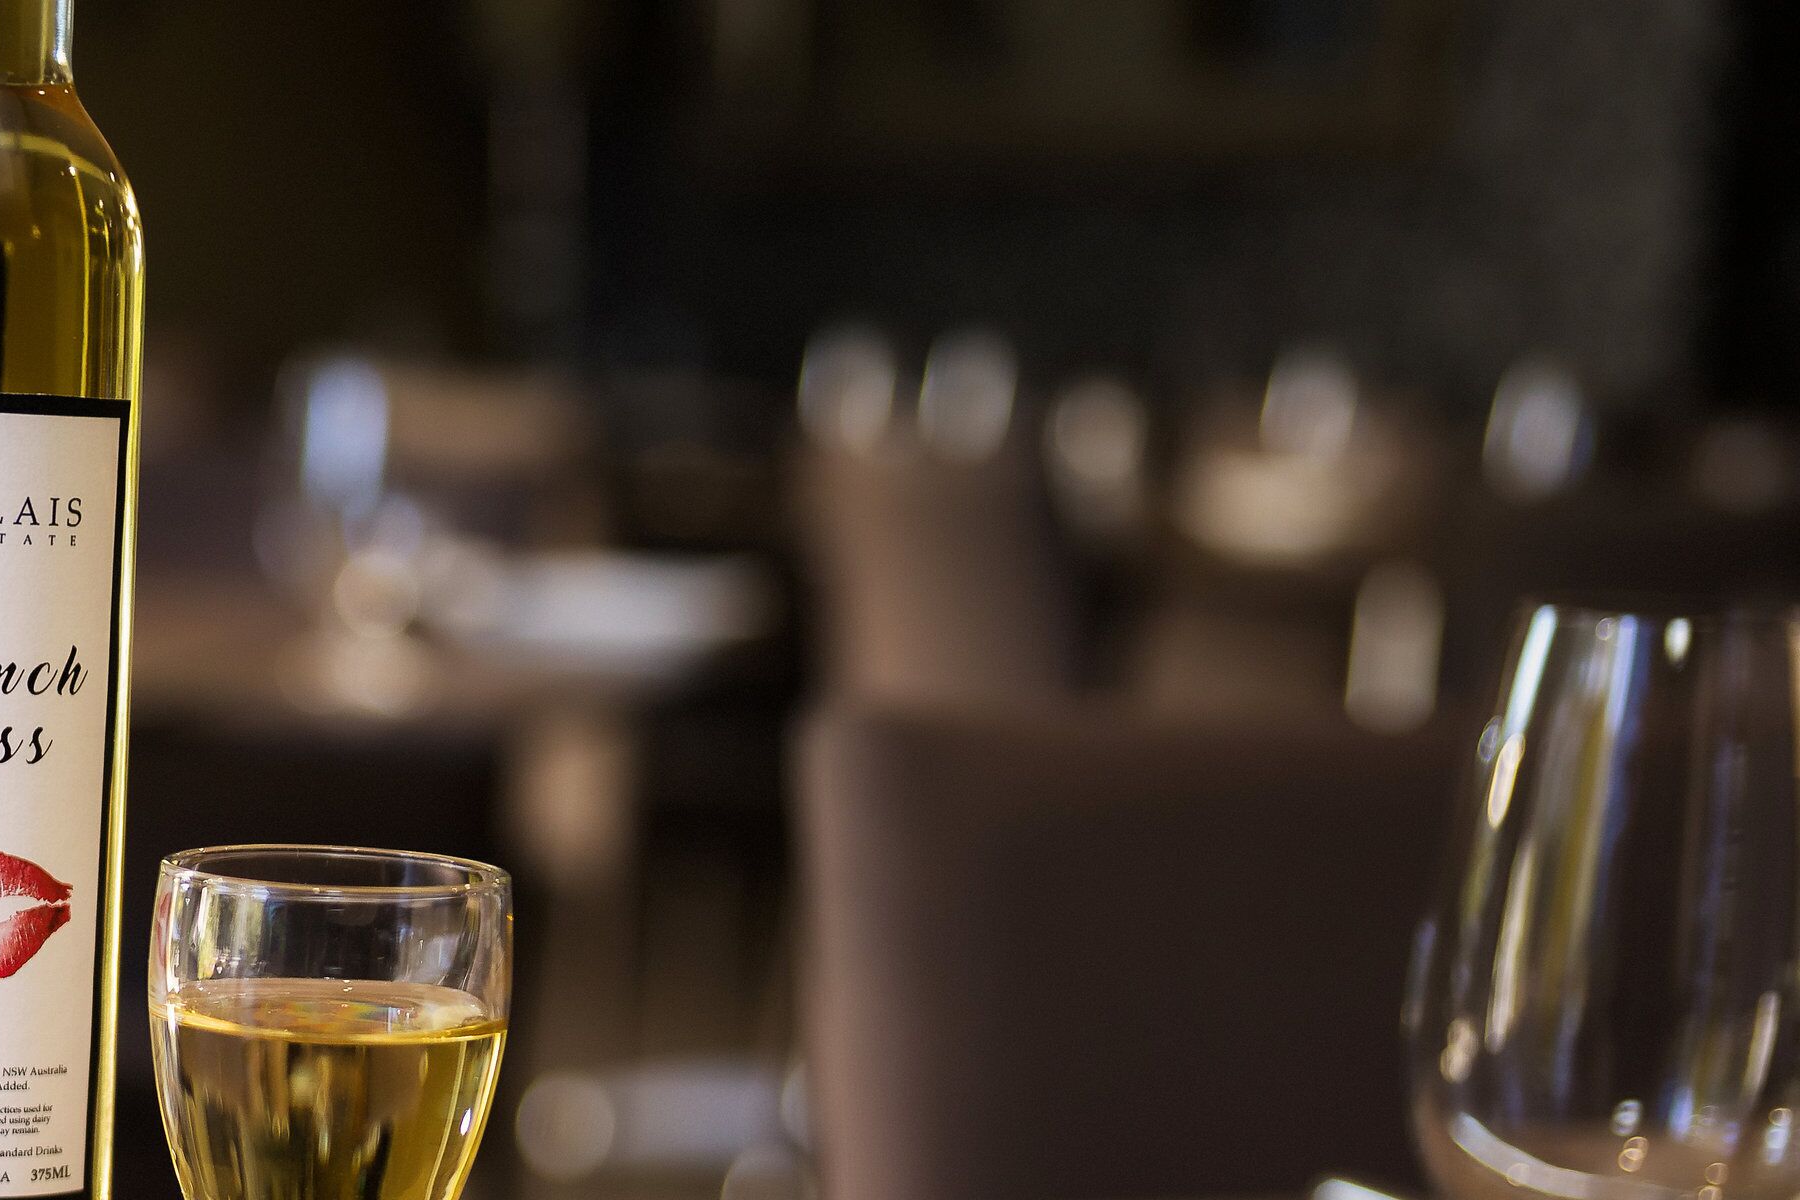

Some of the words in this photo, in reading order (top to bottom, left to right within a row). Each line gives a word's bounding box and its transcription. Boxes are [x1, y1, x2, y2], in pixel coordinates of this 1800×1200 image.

[2, 1067, 28, 1077] NSW
[30, 1064, 68, 1076] Australia
[23, 1104, 41, 1113] used
[42, 1104, 53, 1112] for
[9, 1117, 30, 1126] using
[32, 1115, 51, 1124] dairy
[12, 1126, 41, 1134] remain.
[35, 1145, 63, 1155] Drinks
[30, 1164, 71, 1182] 375ML
